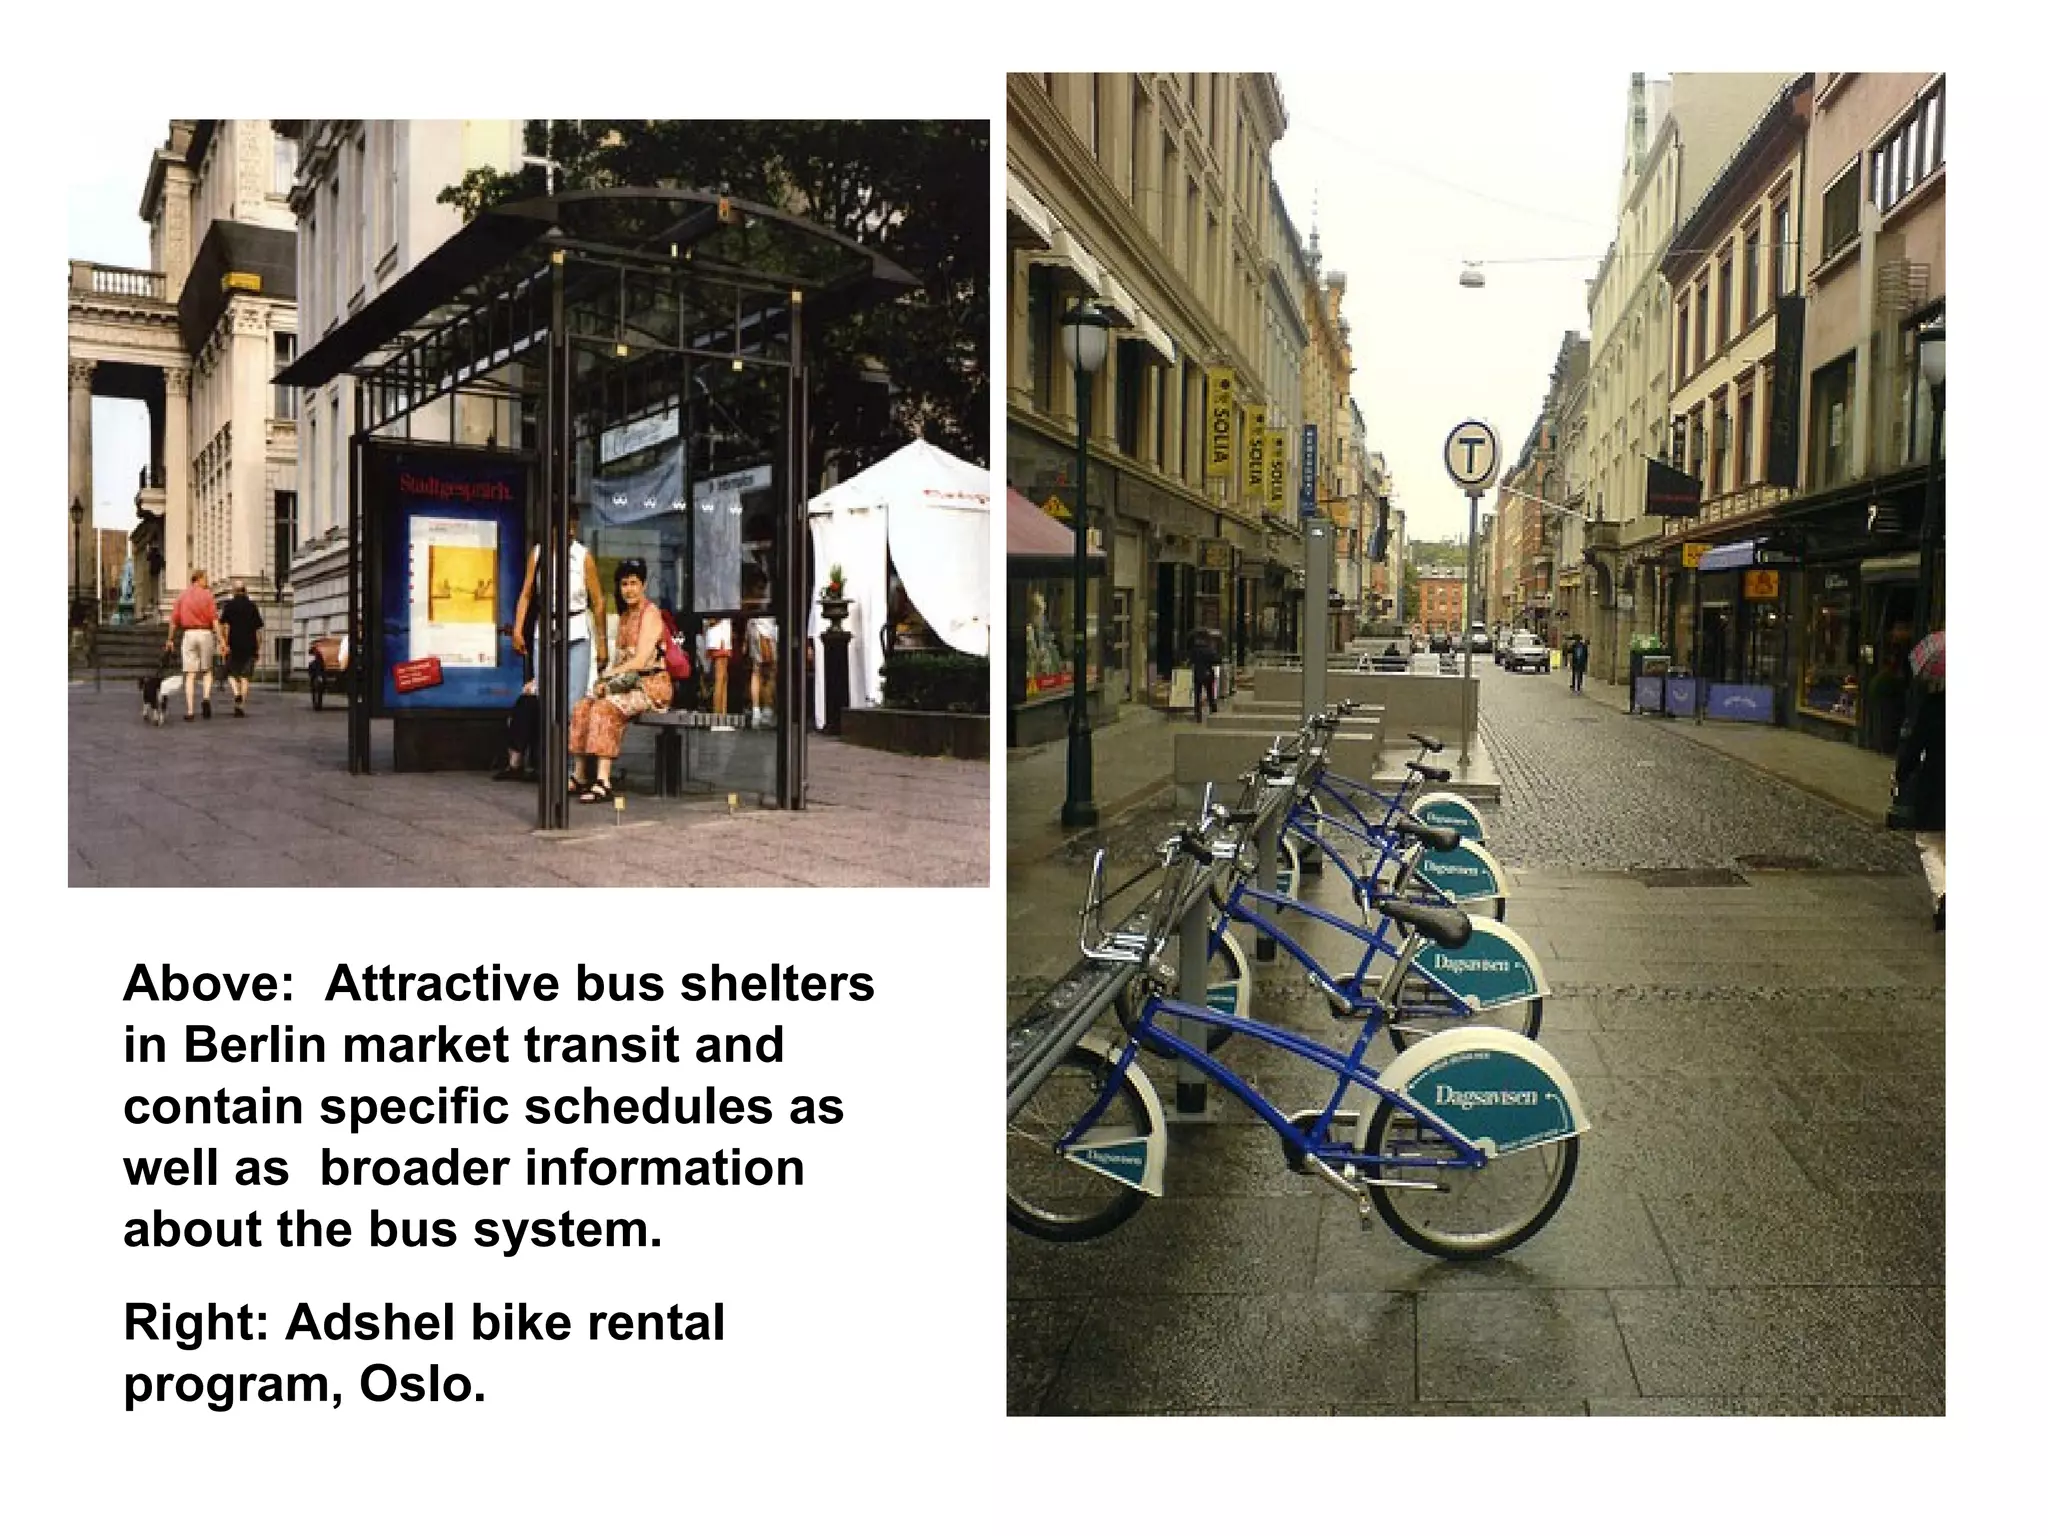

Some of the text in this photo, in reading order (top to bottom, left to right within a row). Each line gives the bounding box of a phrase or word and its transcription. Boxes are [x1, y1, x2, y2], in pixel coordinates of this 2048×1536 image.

[1213, 408, 1230, 462] SOLIA
[1458, 437, 1486, 474] T
[1433, 953, 1510, 975] Dagsavisen
[1436, 1084, 1538, 1111] Dagsavisen
